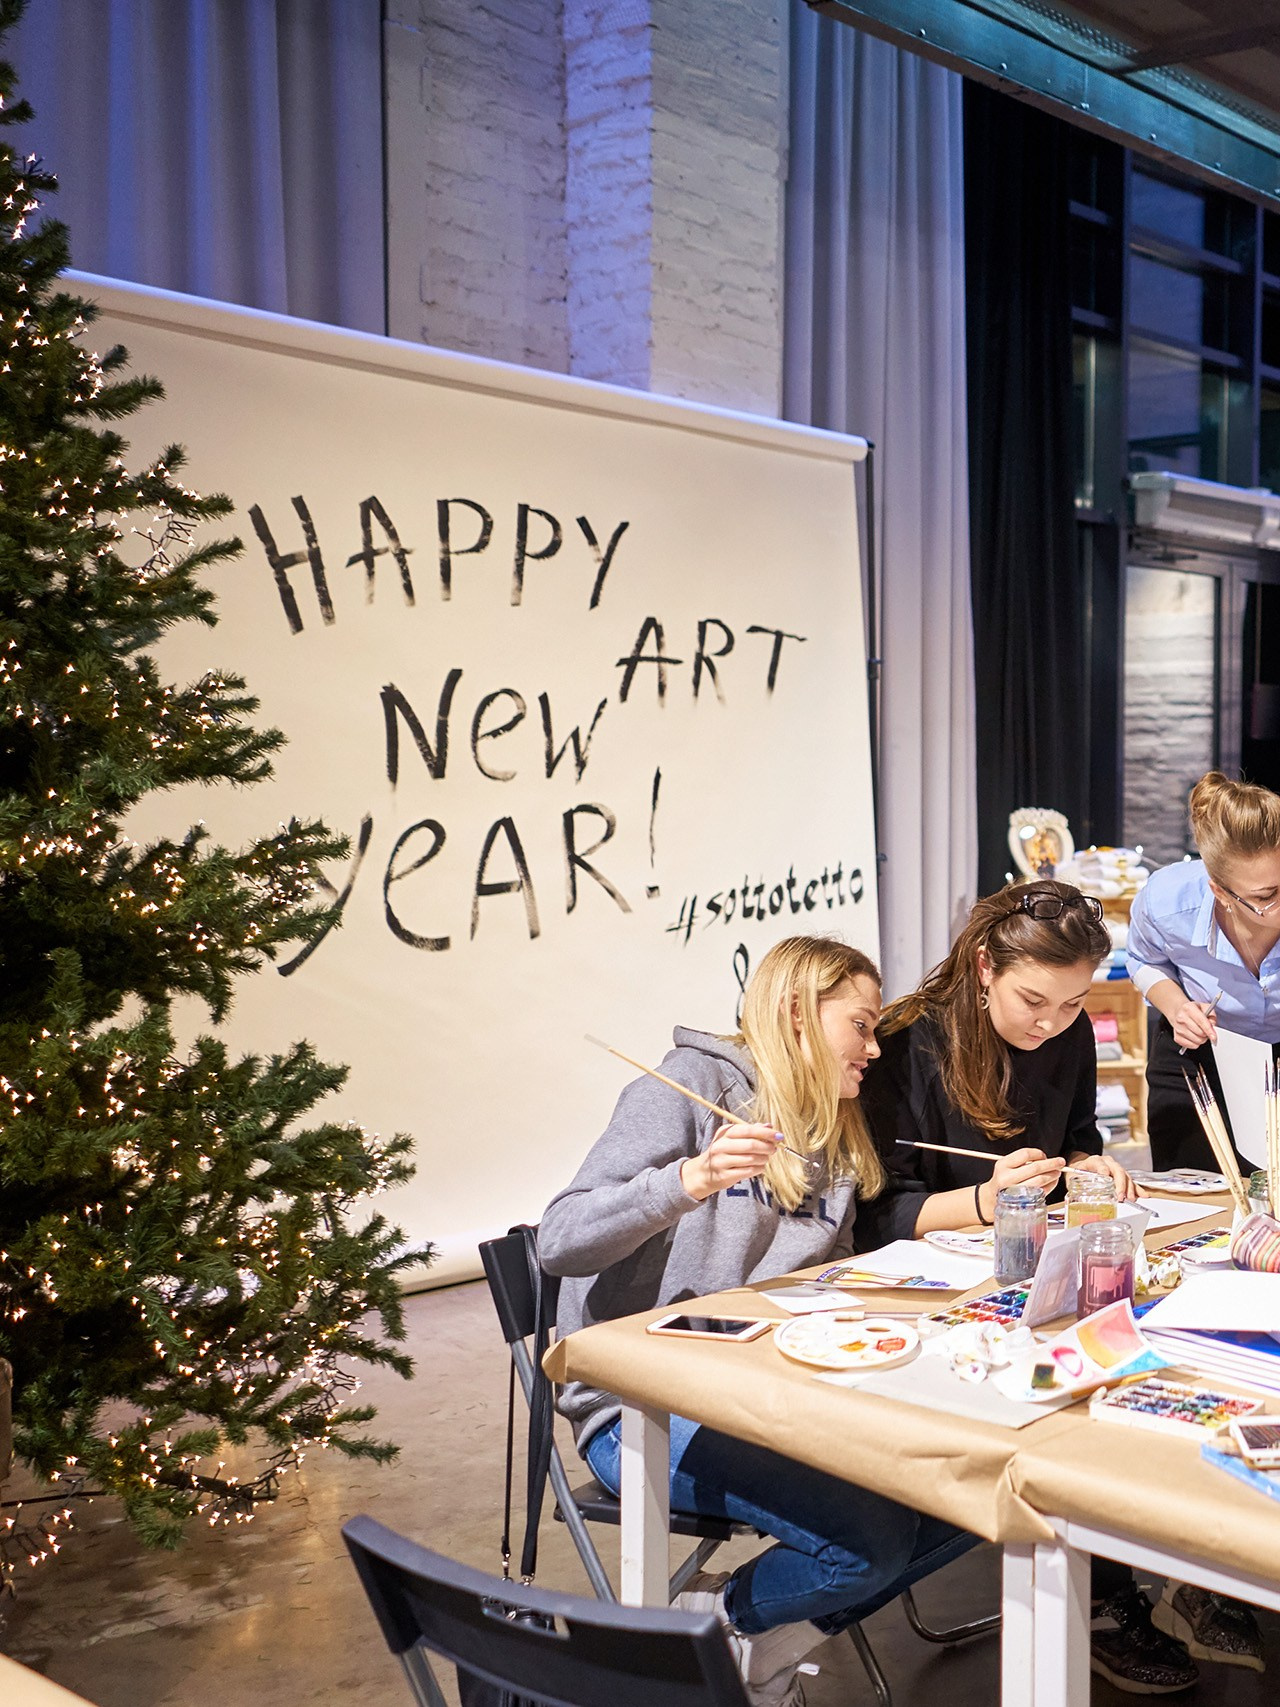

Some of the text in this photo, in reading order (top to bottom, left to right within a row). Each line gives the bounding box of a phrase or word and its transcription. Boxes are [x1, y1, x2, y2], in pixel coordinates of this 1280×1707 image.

[248, 495, 629, 634] HAPPY
[616, 616, 807, 707] ART
[665, 861, 863, 948] #sottotetto
